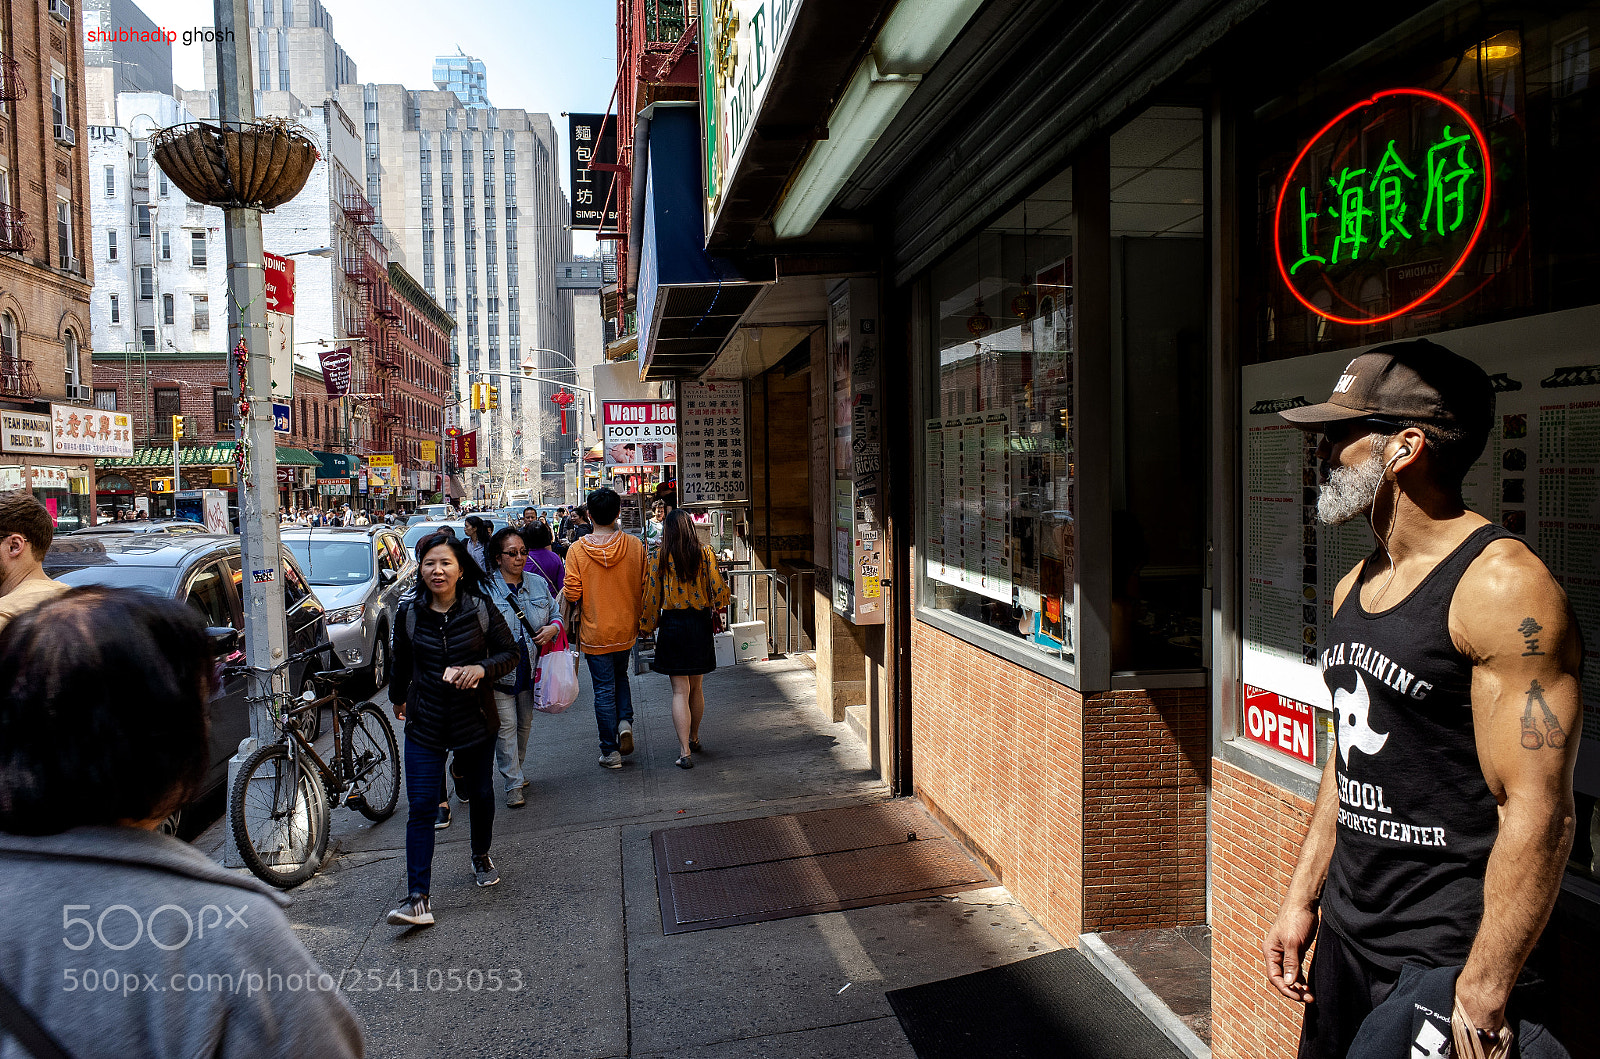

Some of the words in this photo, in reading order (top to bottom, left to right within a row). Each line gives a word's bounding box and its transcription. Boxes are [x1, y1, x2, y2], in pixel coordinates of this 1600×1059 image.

[575, 125, 593, 205] 麵包工坊
[1290, 125, 1475, 275] 上海食府
[575, 210, 604, 219] SIMPLY
[609, 403, 647, 422] Wang
[3, 416, 21, 429] YEAH
[703, 417, 741, 426] 胡兆文
[608, 426, 640, 437] FOOT
[643, 426, 652, 436] &
[703, 427, 741, 437] 胡兆玲
[10, 434, 33, 447] DELUXE
[319, 484, 348, 495] TEA
[685, 481, 745, 494] 212-226-5530
[1348, 642, 1434, 701] TRAINING
[1247, 705, 1310, 757] OPEN
[1379, 819, 1447, 847] CENTER
